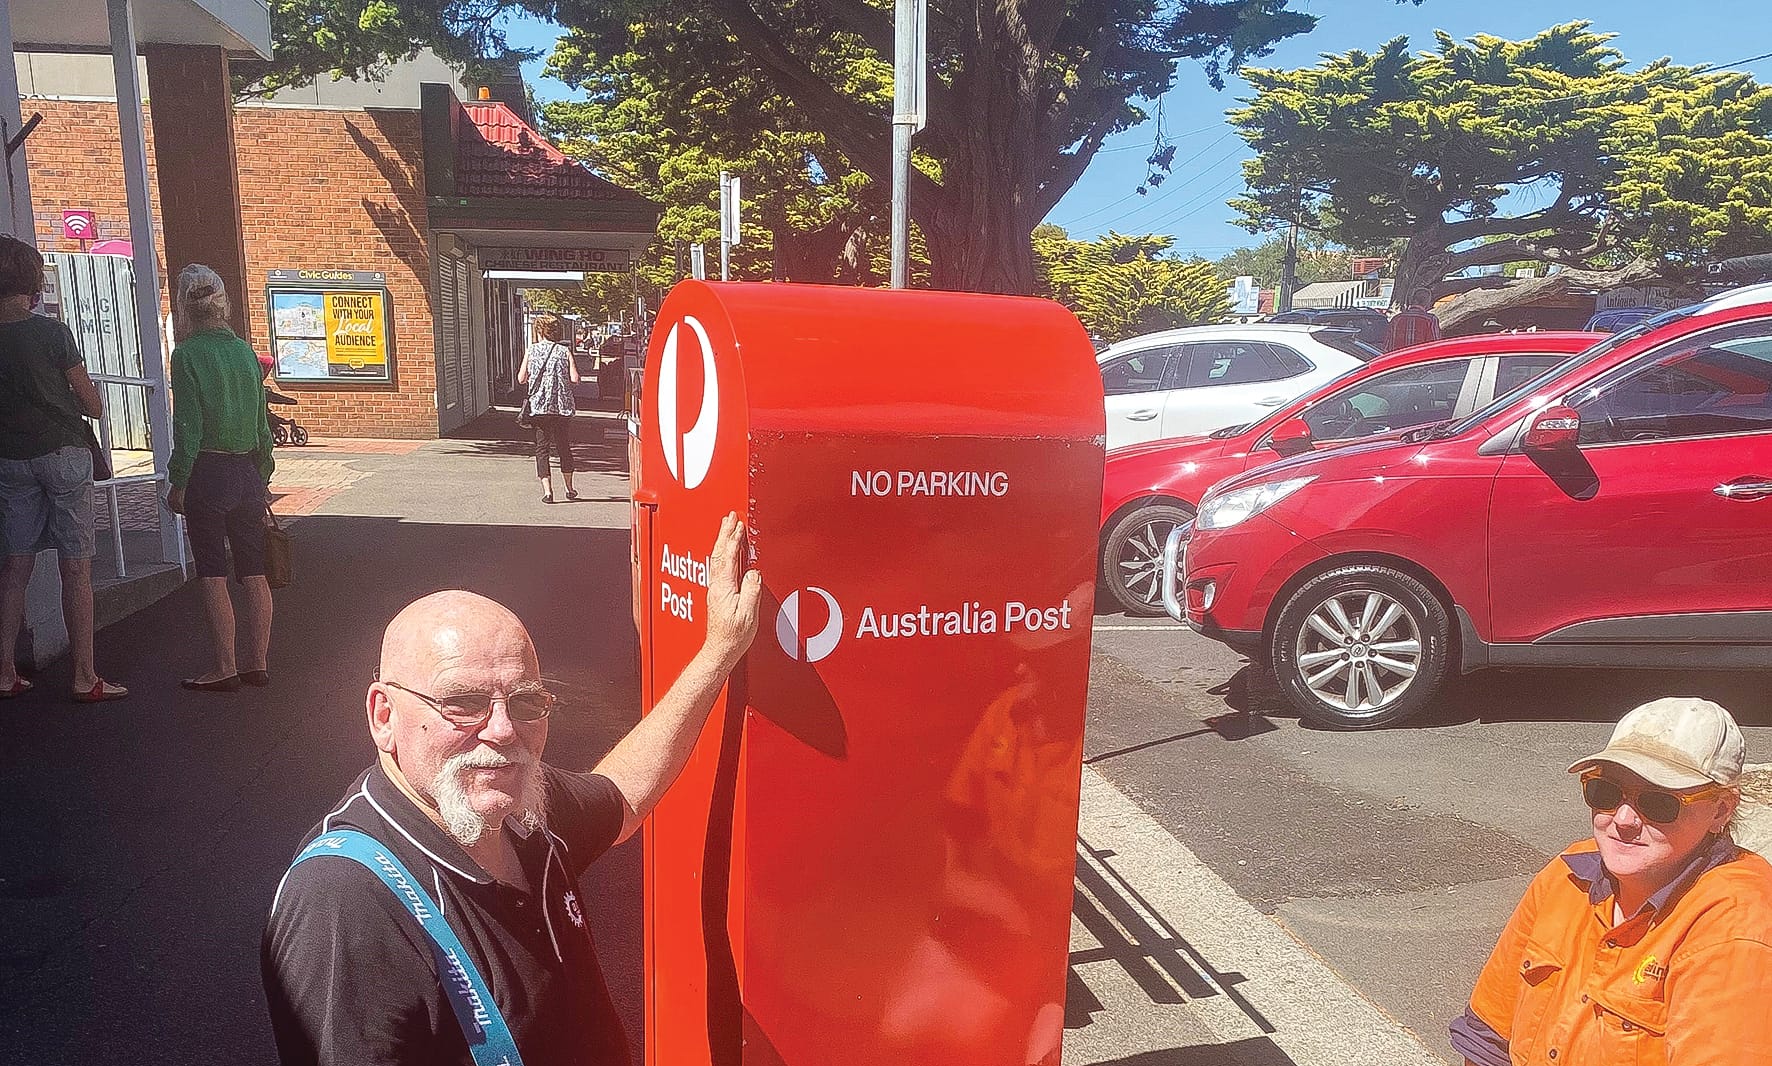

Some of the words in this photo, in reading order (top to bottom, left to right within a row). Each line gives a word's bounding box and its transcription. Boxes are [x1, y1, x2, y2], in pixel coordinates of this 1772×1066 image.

[485, 259, 537, 269] CHINESE
[539, 260, 624, 271] RESTAURANT
[299, 270, 321, 279] Civic
[321, 270, 354, 280] Guides
[332, 296, 373, 308] CONNECT
[333, 308, 353, 319] WITH
[354, 309, 375, 320] YOUR
[333, 314, 373, 336] Local
[335, 335, 376, 346] AUDIENCE
[851, 471, 892, 496] NO
[896, 472, 1009, 497] PARKING
[661, 543, 710, 588] Austral
[661, 582, 693, 622] Post
[855, 602, 997, 639] Australia
[1004, 600, 1072, 632] Post
